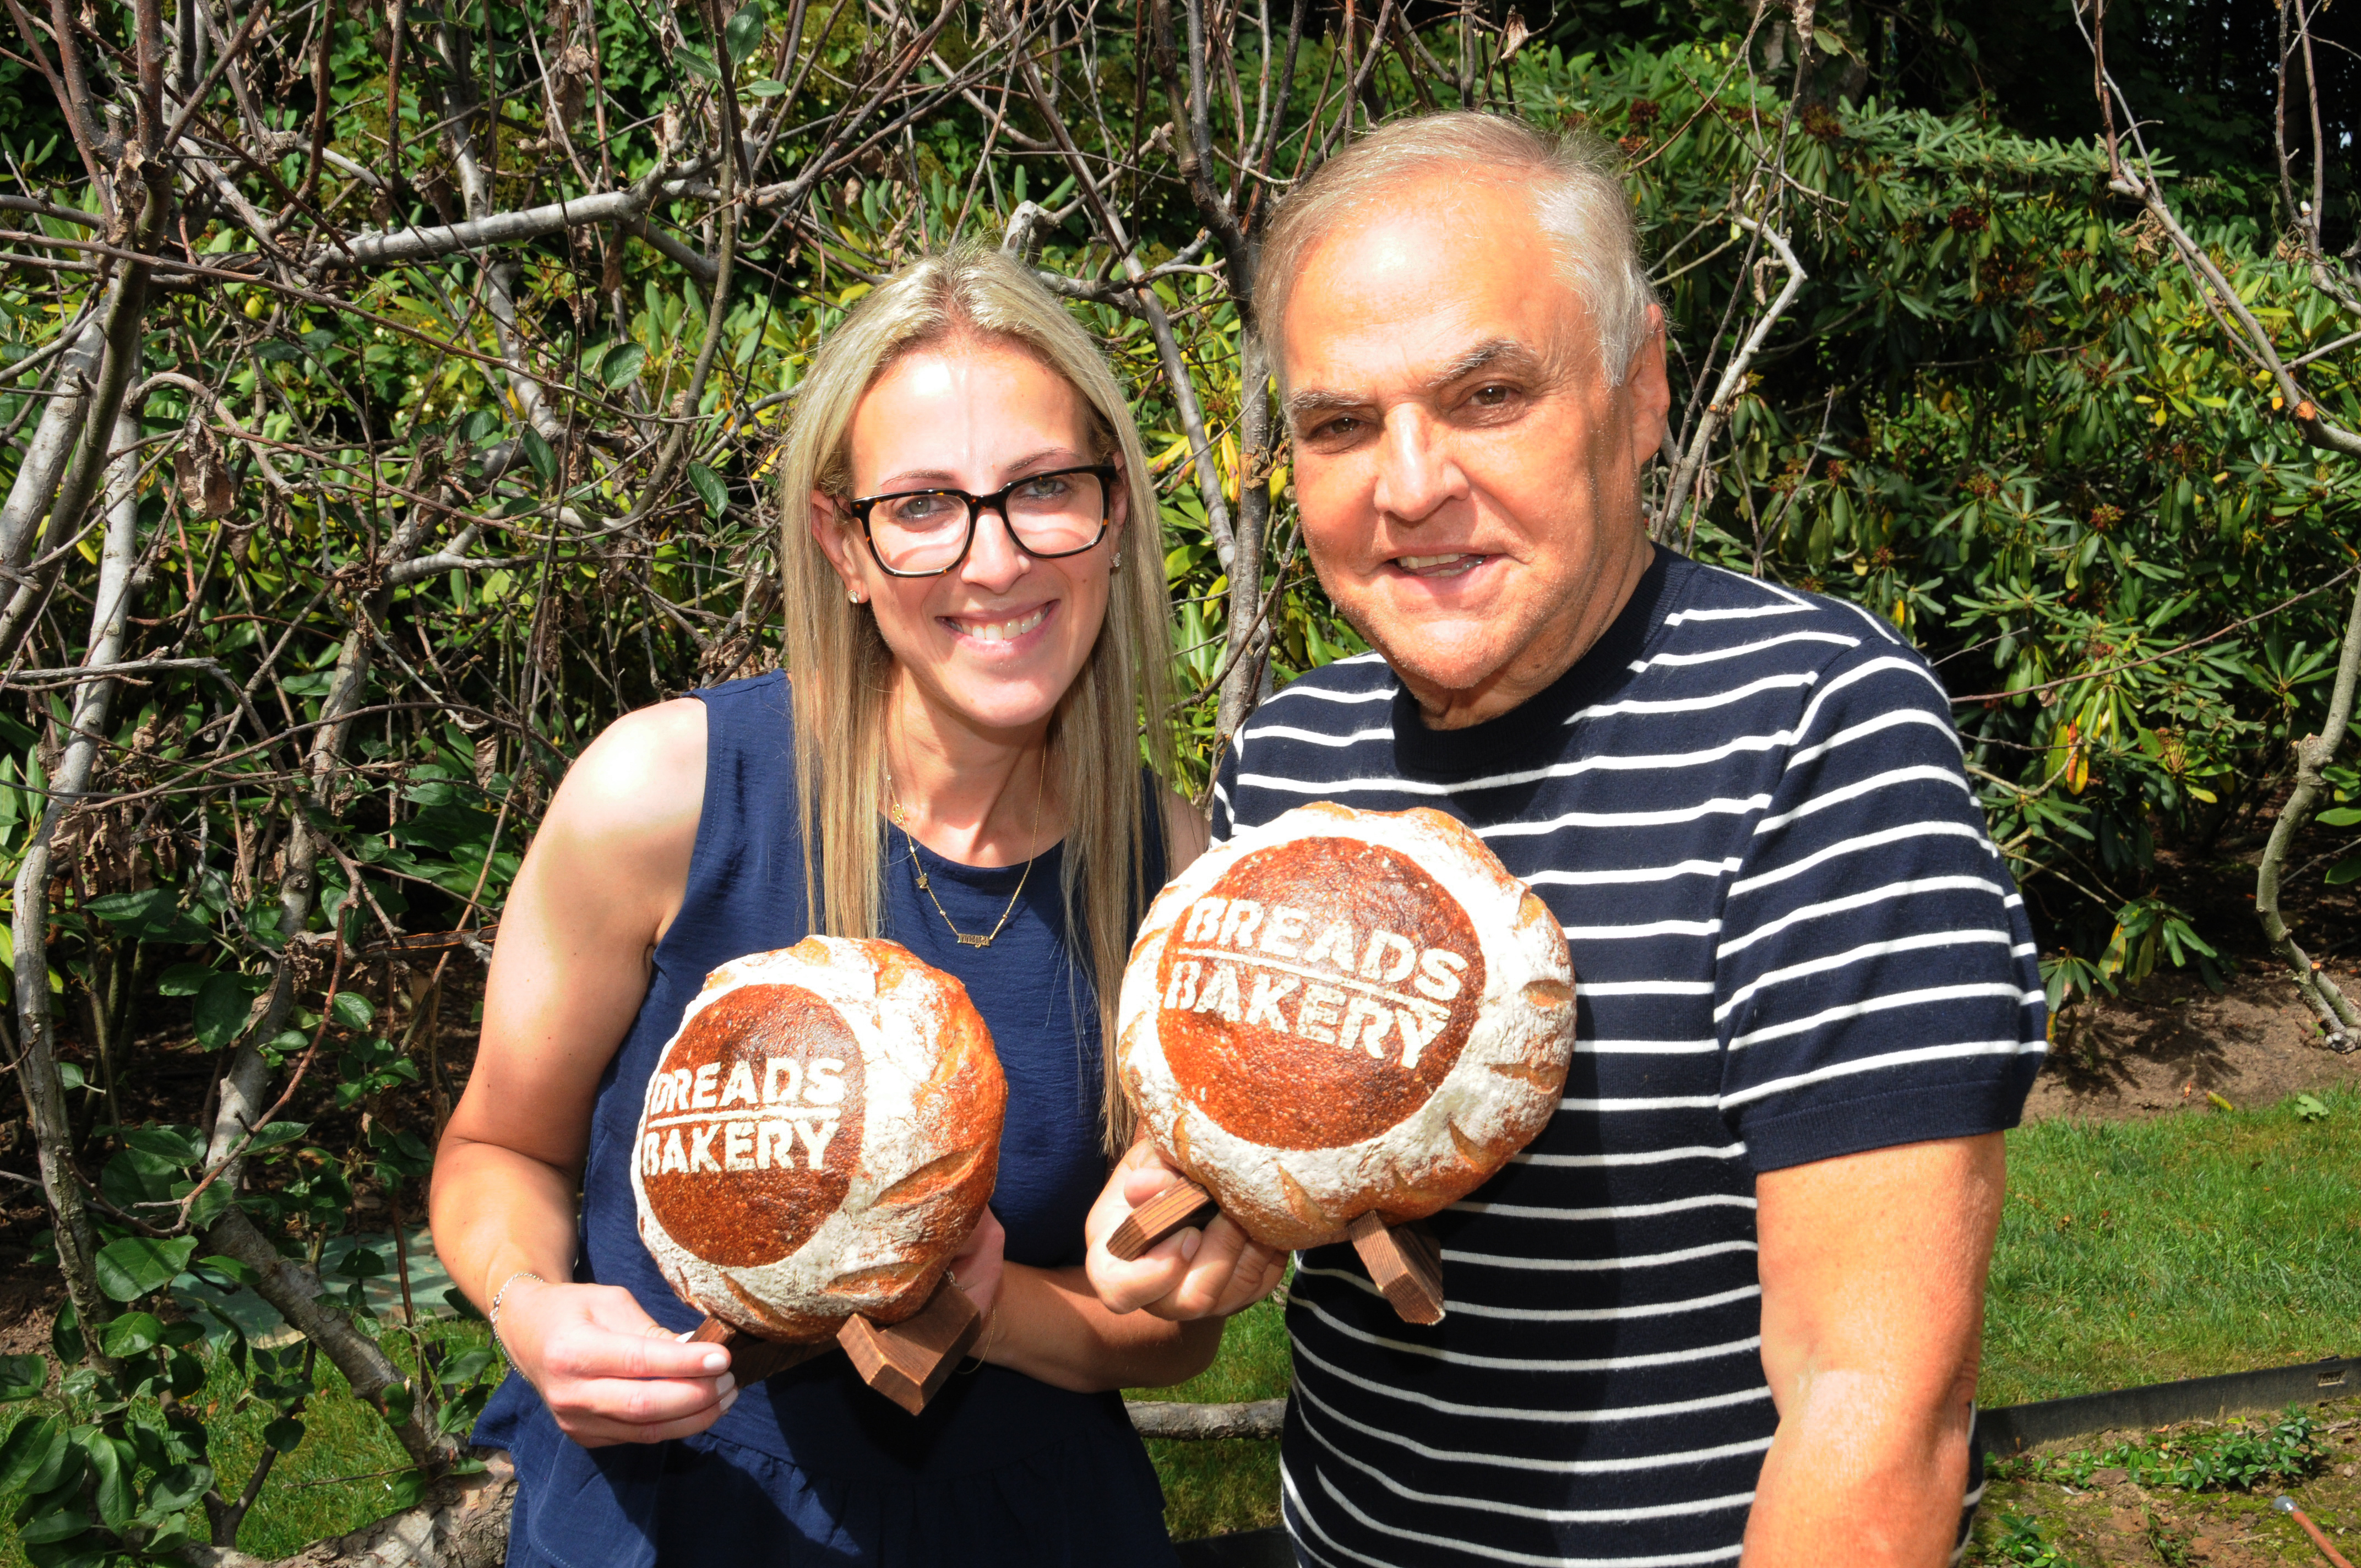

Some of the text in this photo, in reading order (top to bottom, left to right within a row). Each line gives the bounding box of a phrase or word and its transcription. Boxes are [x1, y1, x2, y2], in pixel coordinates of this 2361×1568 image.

[1184, 896, 1468, 1001] BREADS
[1163, 960, 1451, 1069] BAKERY
[641, 1119, 840, 1177] BAKERY
